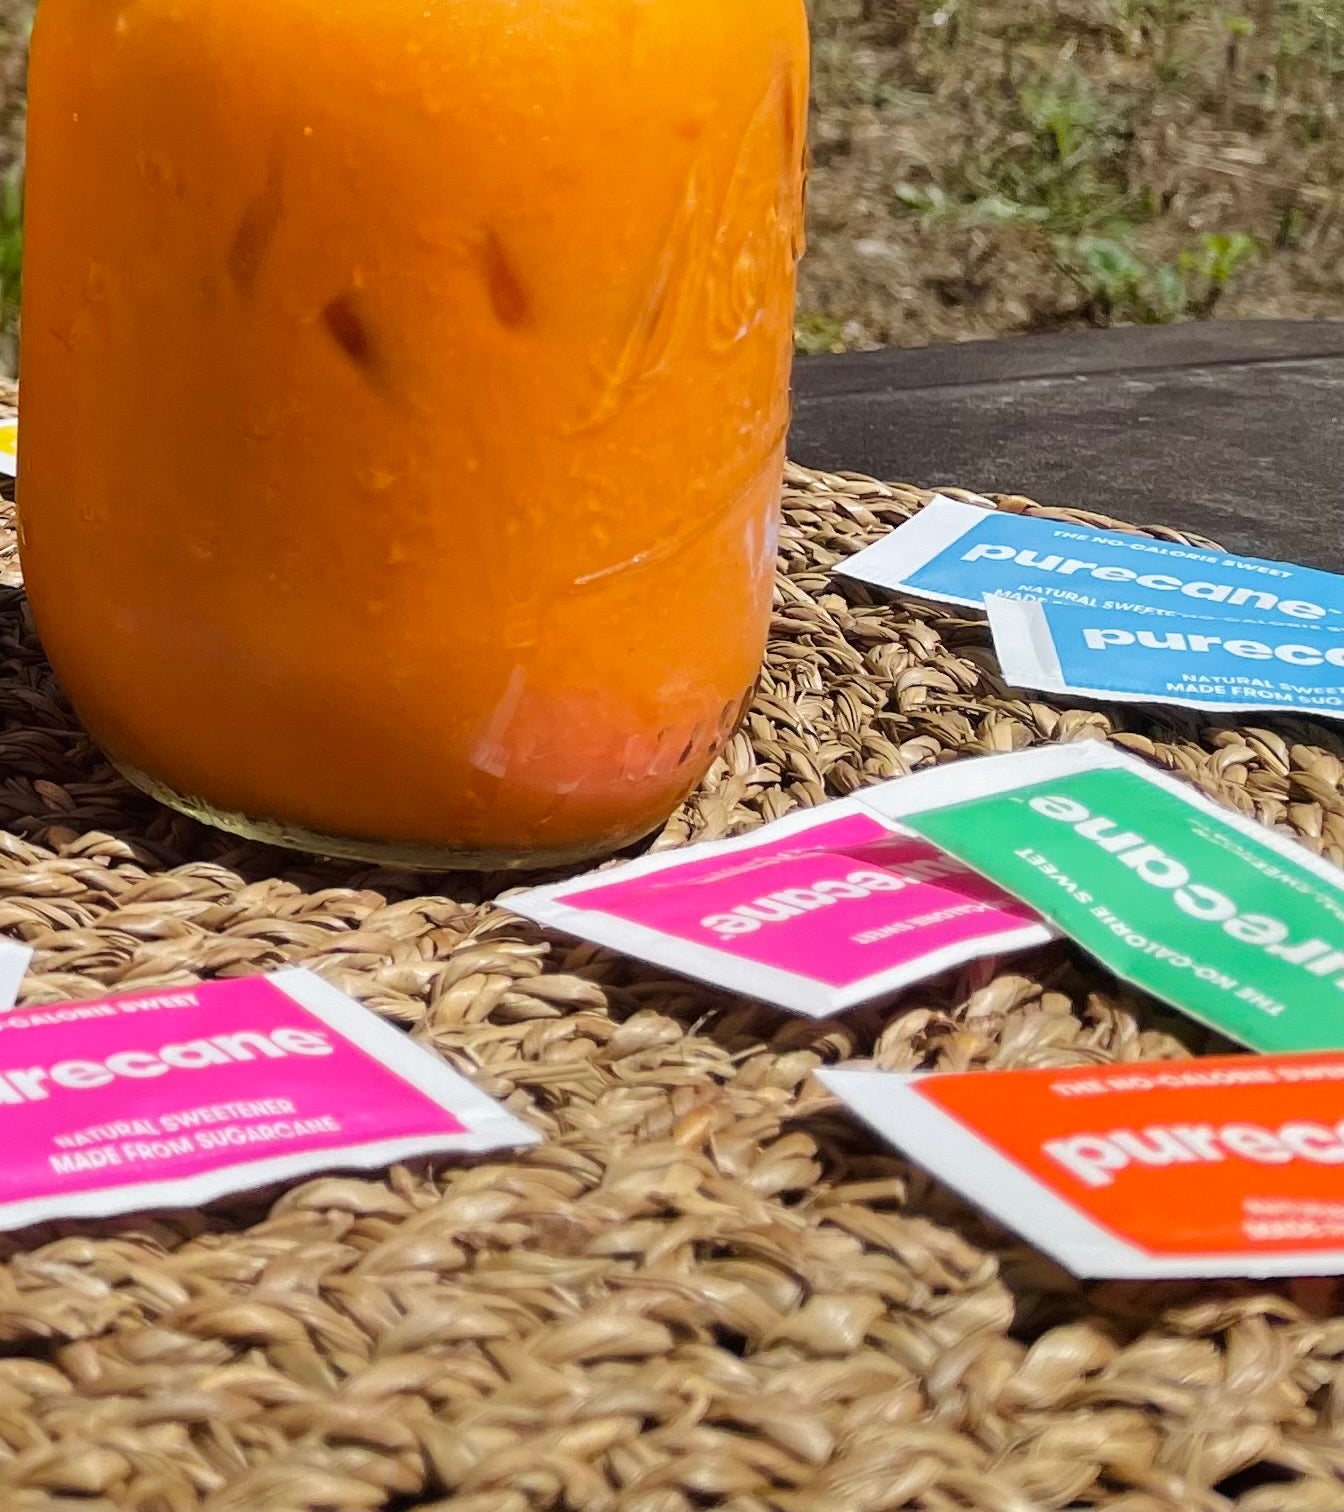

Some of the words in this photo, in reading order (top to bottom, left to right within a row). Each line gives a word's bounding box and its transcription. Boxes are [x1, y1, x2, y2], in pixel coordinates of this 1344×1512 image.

[1052, 529, 1089, 541] THE
[1092, 535, 1219, 565] NO-CALORIE
[1222, 558, 1294, 579] SWEET
[1018, 584, 1098, 609] NATURAL
[1166, 682, 1226, 695] MADE
[1231, 686, 1293, 702] FROM
[1182, 673, 1274, 689] NATURAL
[1014, 848, 1094, 904] SWEET
[1090, 906, 1238, 990] NO-CALORIE
[110, 992, 200, 1016] SWEET
[1235, 987, 1285, 1017] THE
[52, 1118, 158, 1149] NATURAL
[160, 1098, 297, 1132] SWEETENER
[48, 1149, 121, 1176] MADE
[122, 1136, 194, 1164] FROM
[195, 1114, 342, 1151] SUGARCANE
